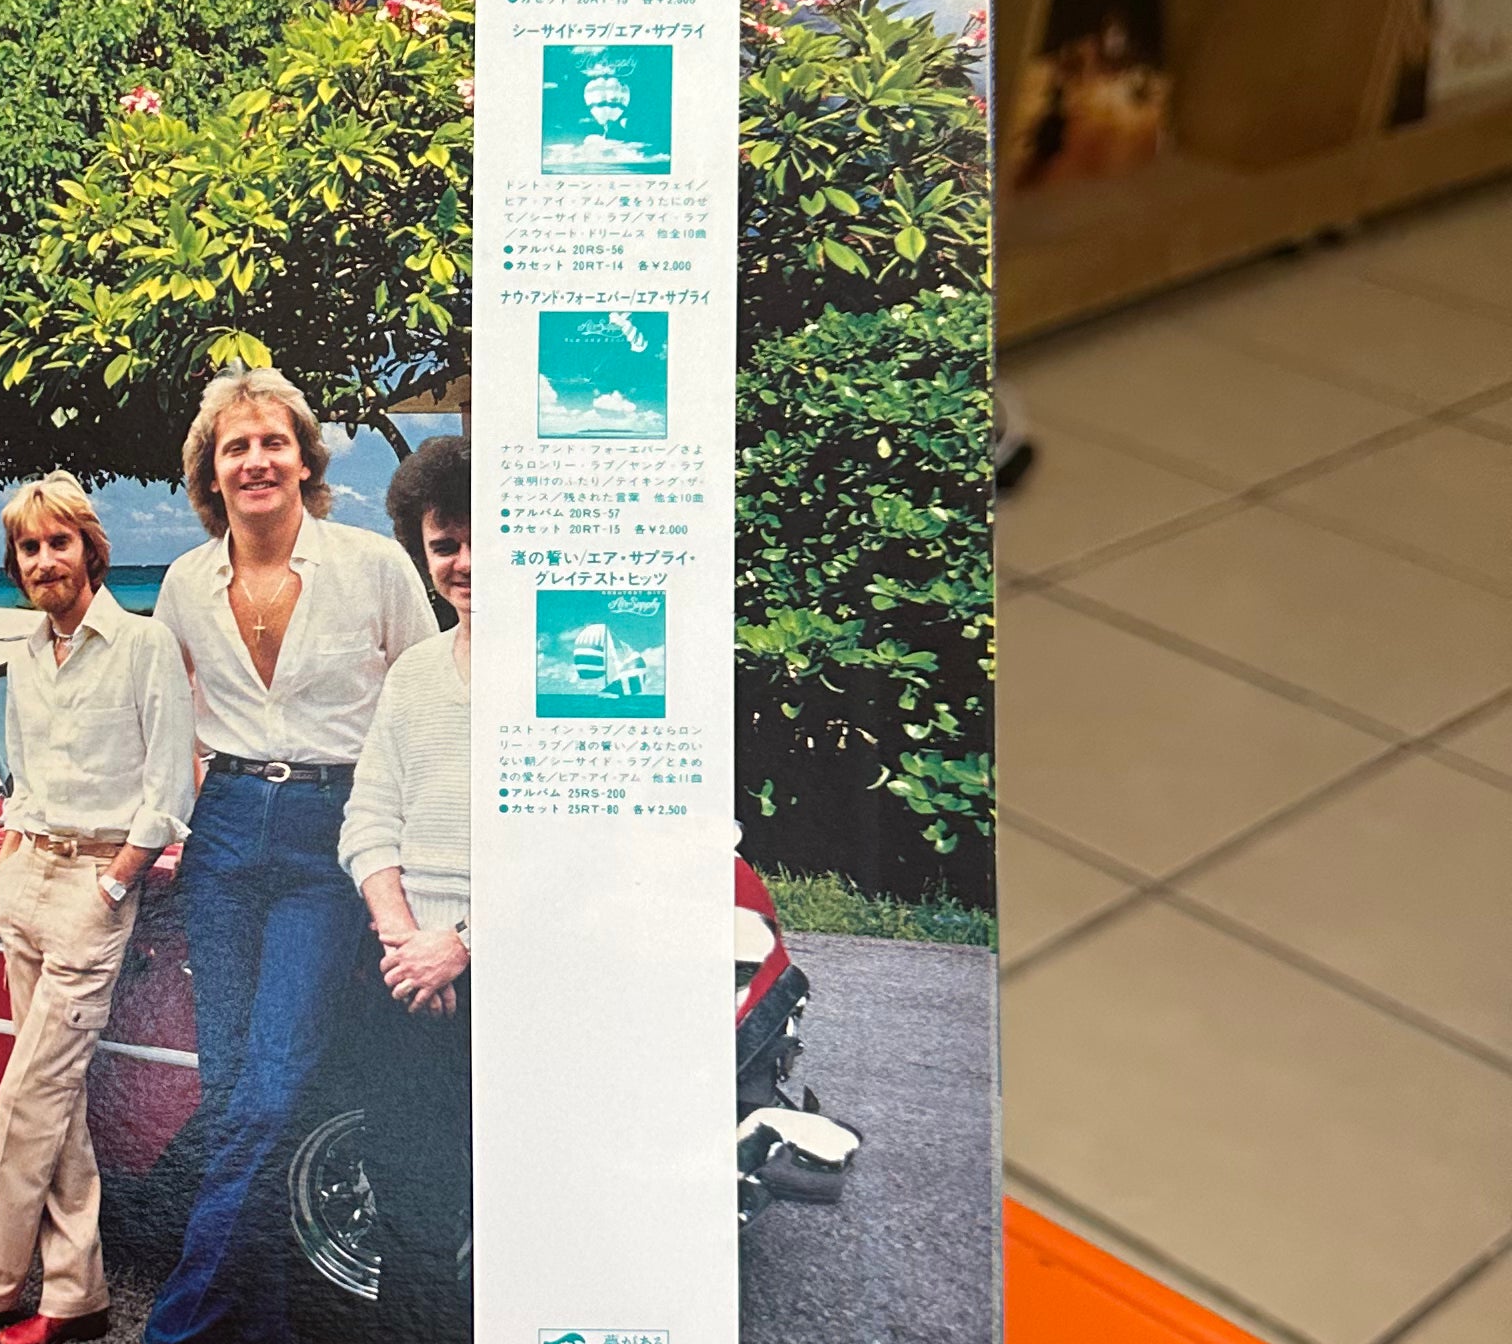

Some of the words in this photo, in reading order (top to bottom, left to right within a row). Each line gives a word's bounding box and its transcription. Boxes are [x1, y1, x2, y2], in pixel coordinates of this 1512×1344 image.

[517, 245, 567, 254] アルバム
[572, 244, 624, 255] 20RS-56
[516, 260, 564, 271] カセット
[572, 260, 624, 271] 20RT-14
[514, 508, 564, 518] アルバム
[513, 524, 561, 534] カセット
[511, 788, 561, 798] アルバム
[511, 804, 559, 814] カセット
